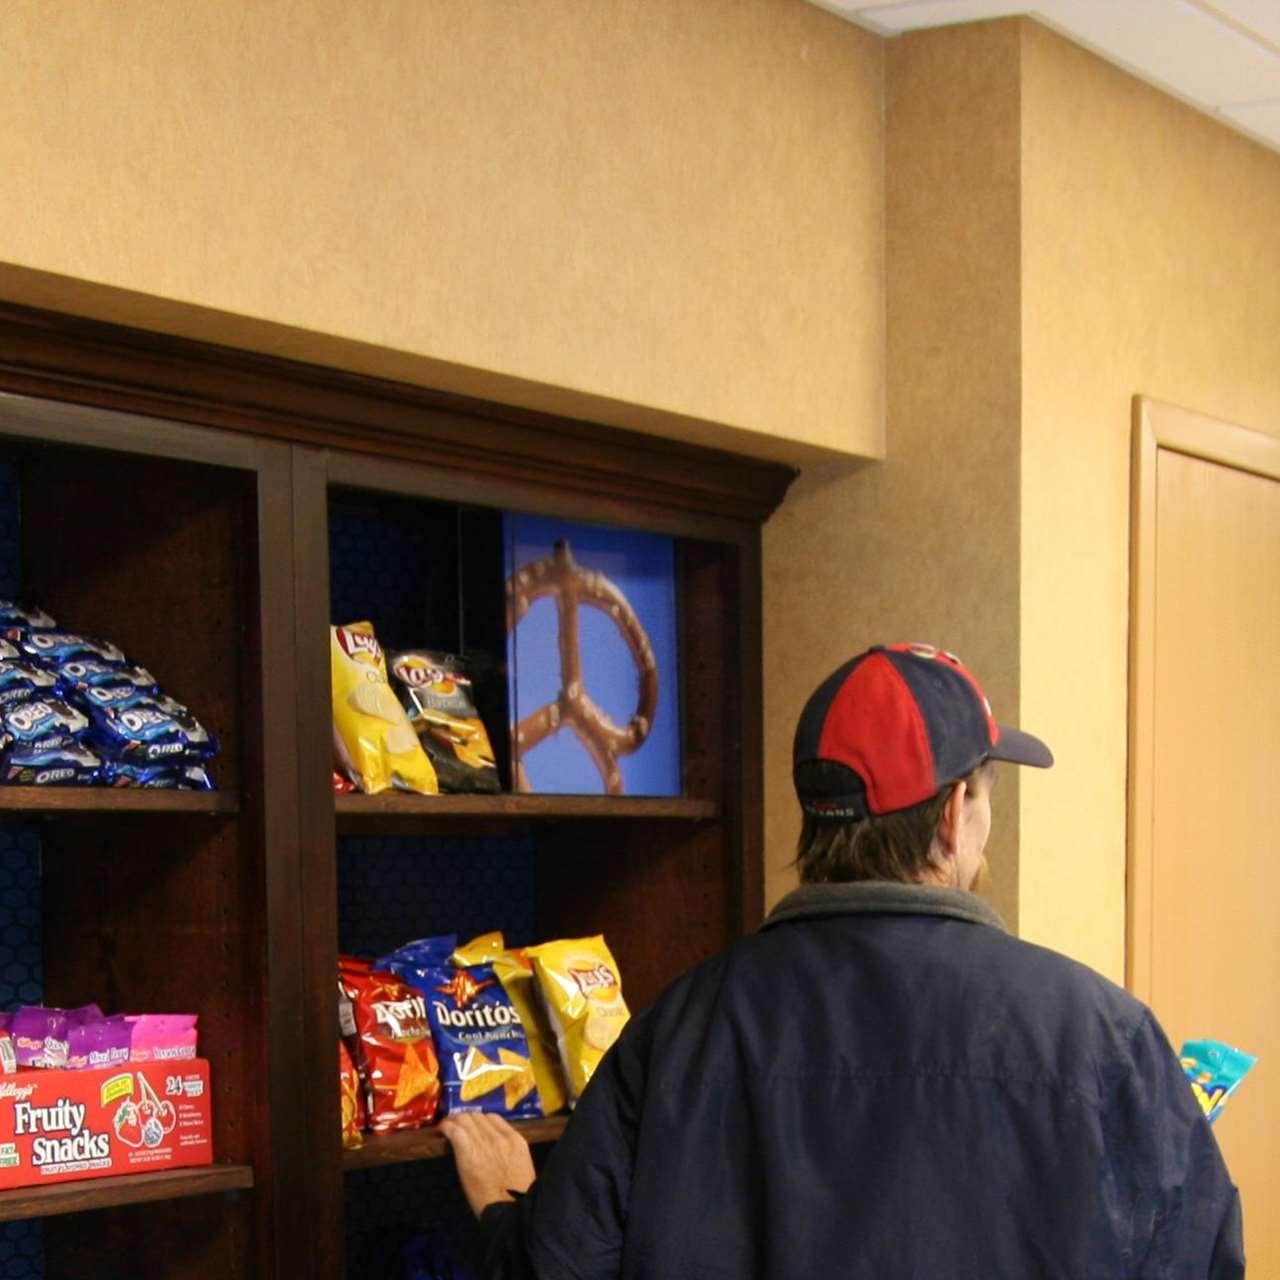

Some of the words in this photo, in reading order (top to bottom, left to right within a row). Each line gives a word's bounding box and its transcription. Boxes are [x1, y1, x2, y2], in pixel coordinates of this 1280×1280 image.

[8, 699, 52, 731] OREO
[36, 767, 75, 784] OREO
[432, 1000, 521, 1028] Doritos
[166, 1076, 182, 1095] 24
[14, 1097, 86, 1136] Fruity
